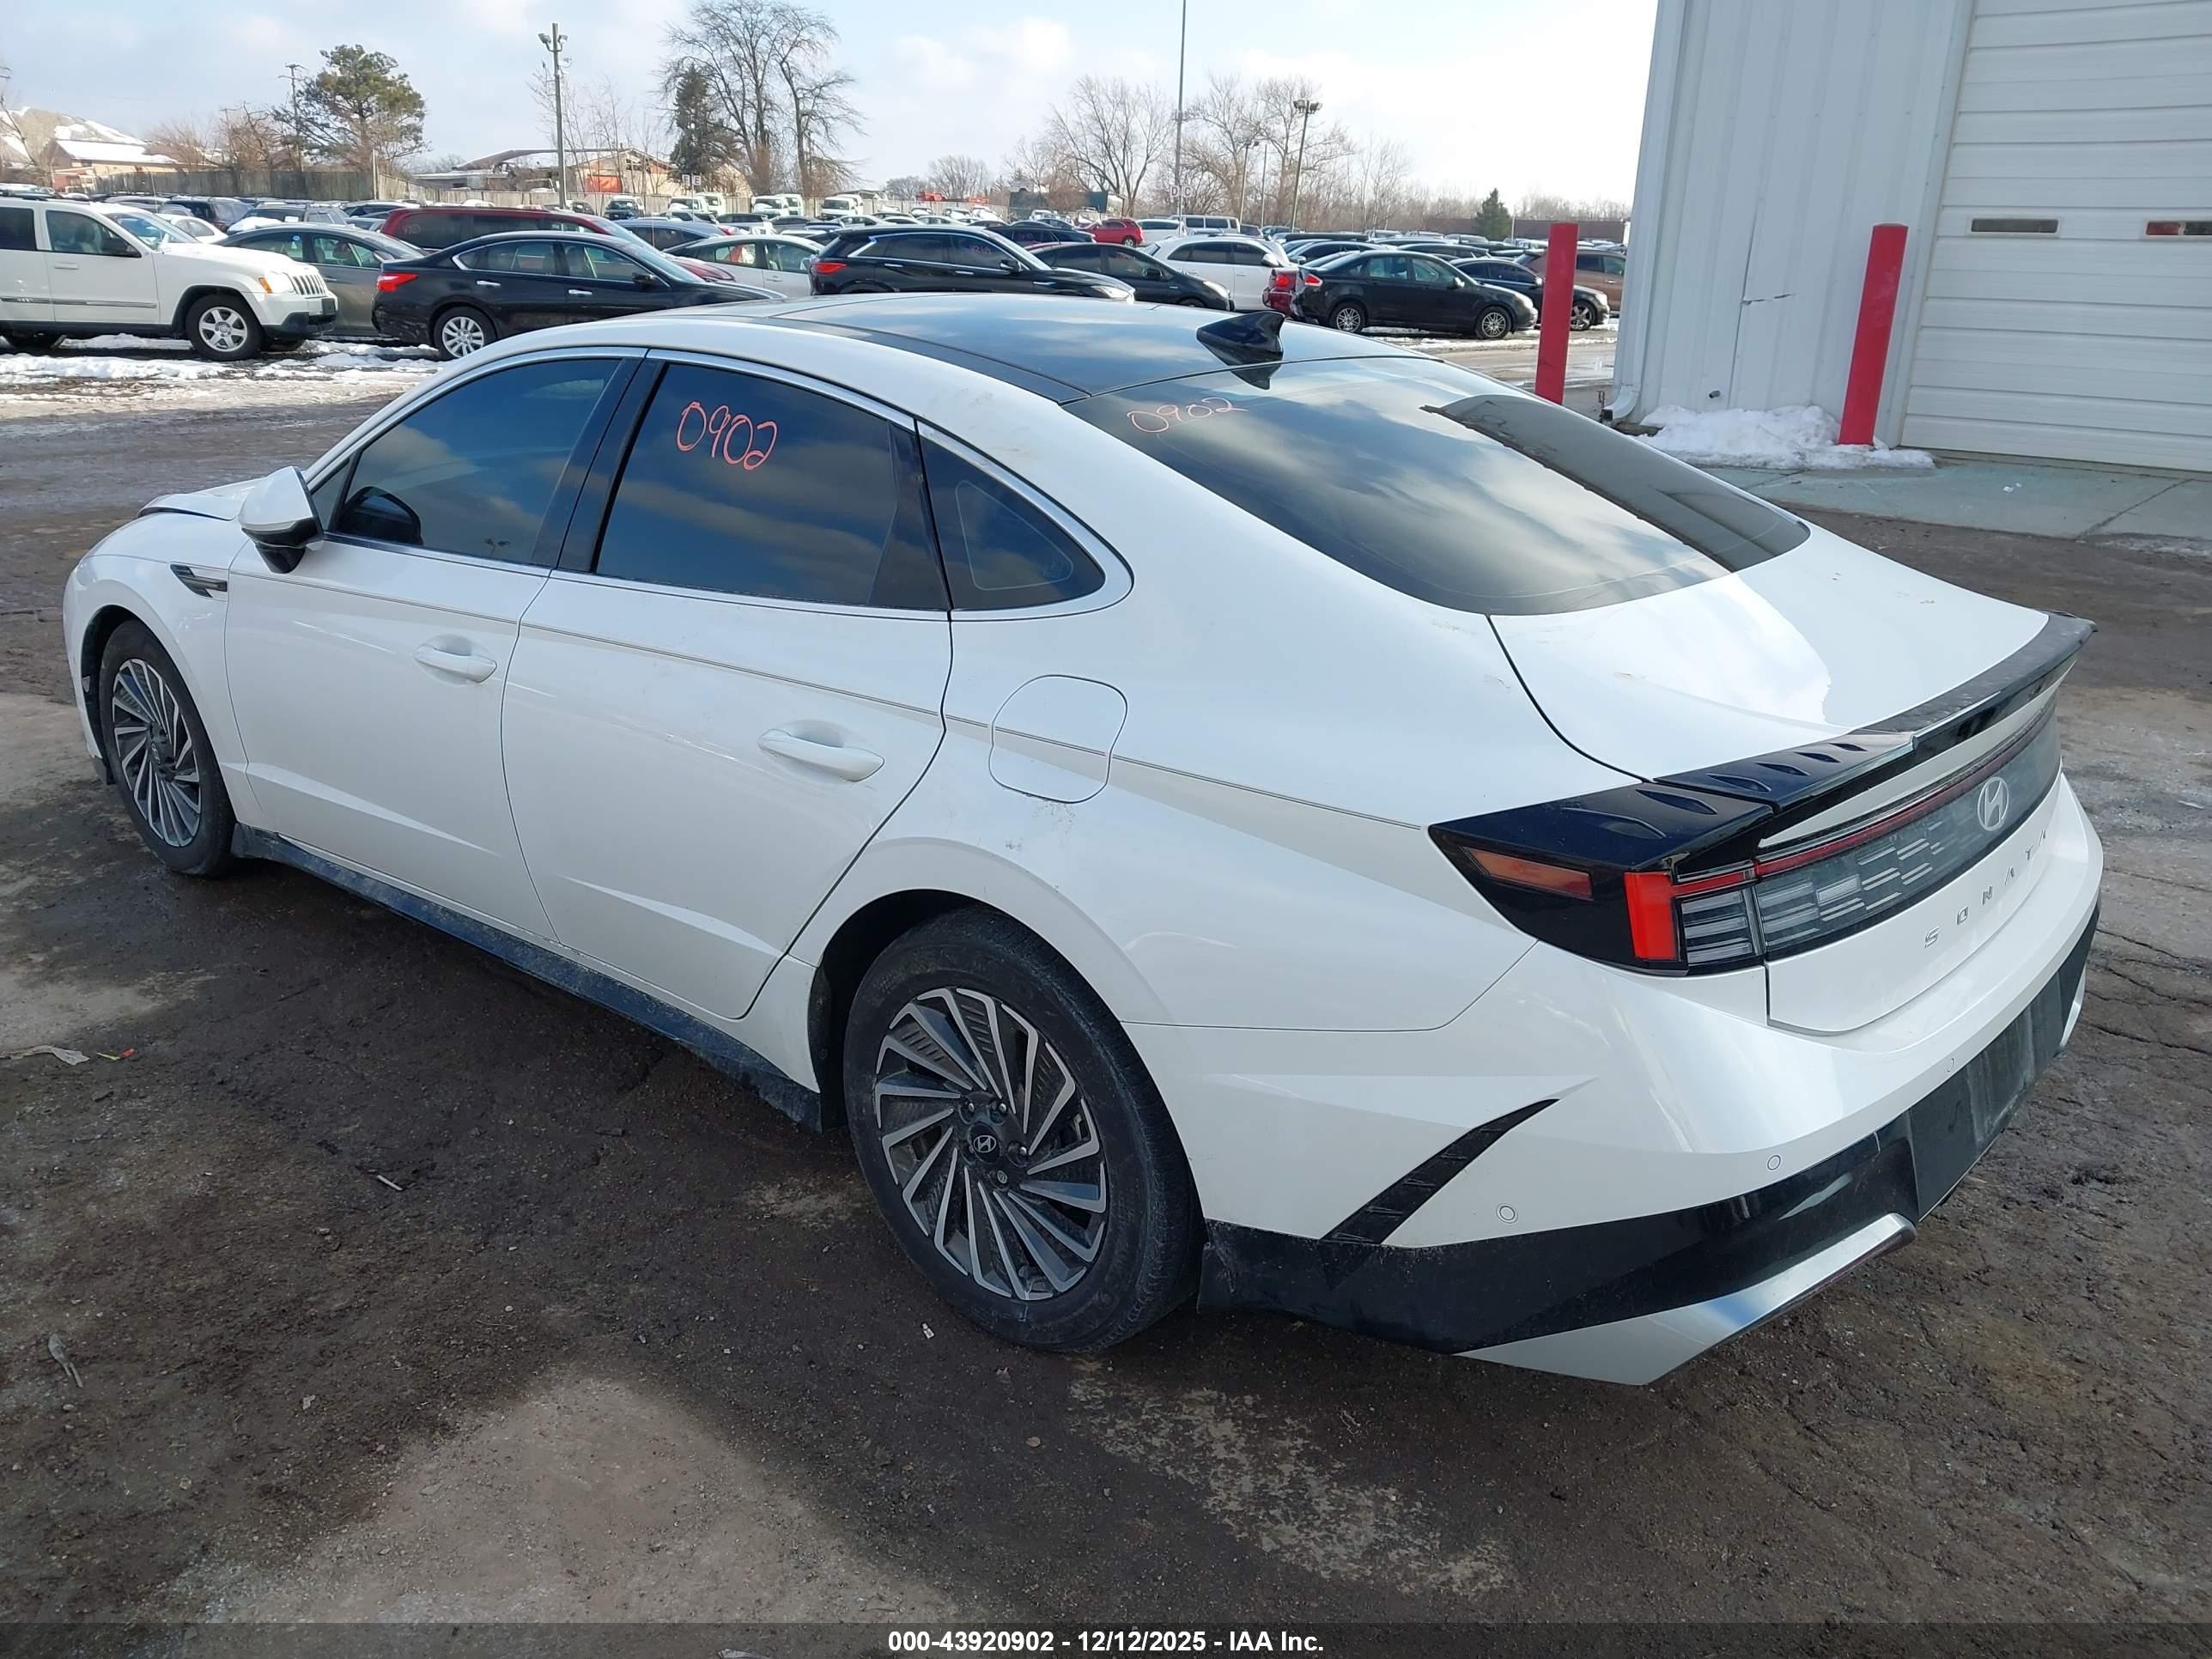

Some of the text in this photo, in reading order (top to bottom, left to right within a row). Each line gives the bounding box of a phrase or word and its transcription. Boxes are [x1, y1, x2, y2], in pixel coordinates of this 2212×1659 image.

[677, 401, 778, 471] 0902
[1127, 397, 1249, 433] 0902
[1924, 829, 2046, 949] SONATA
